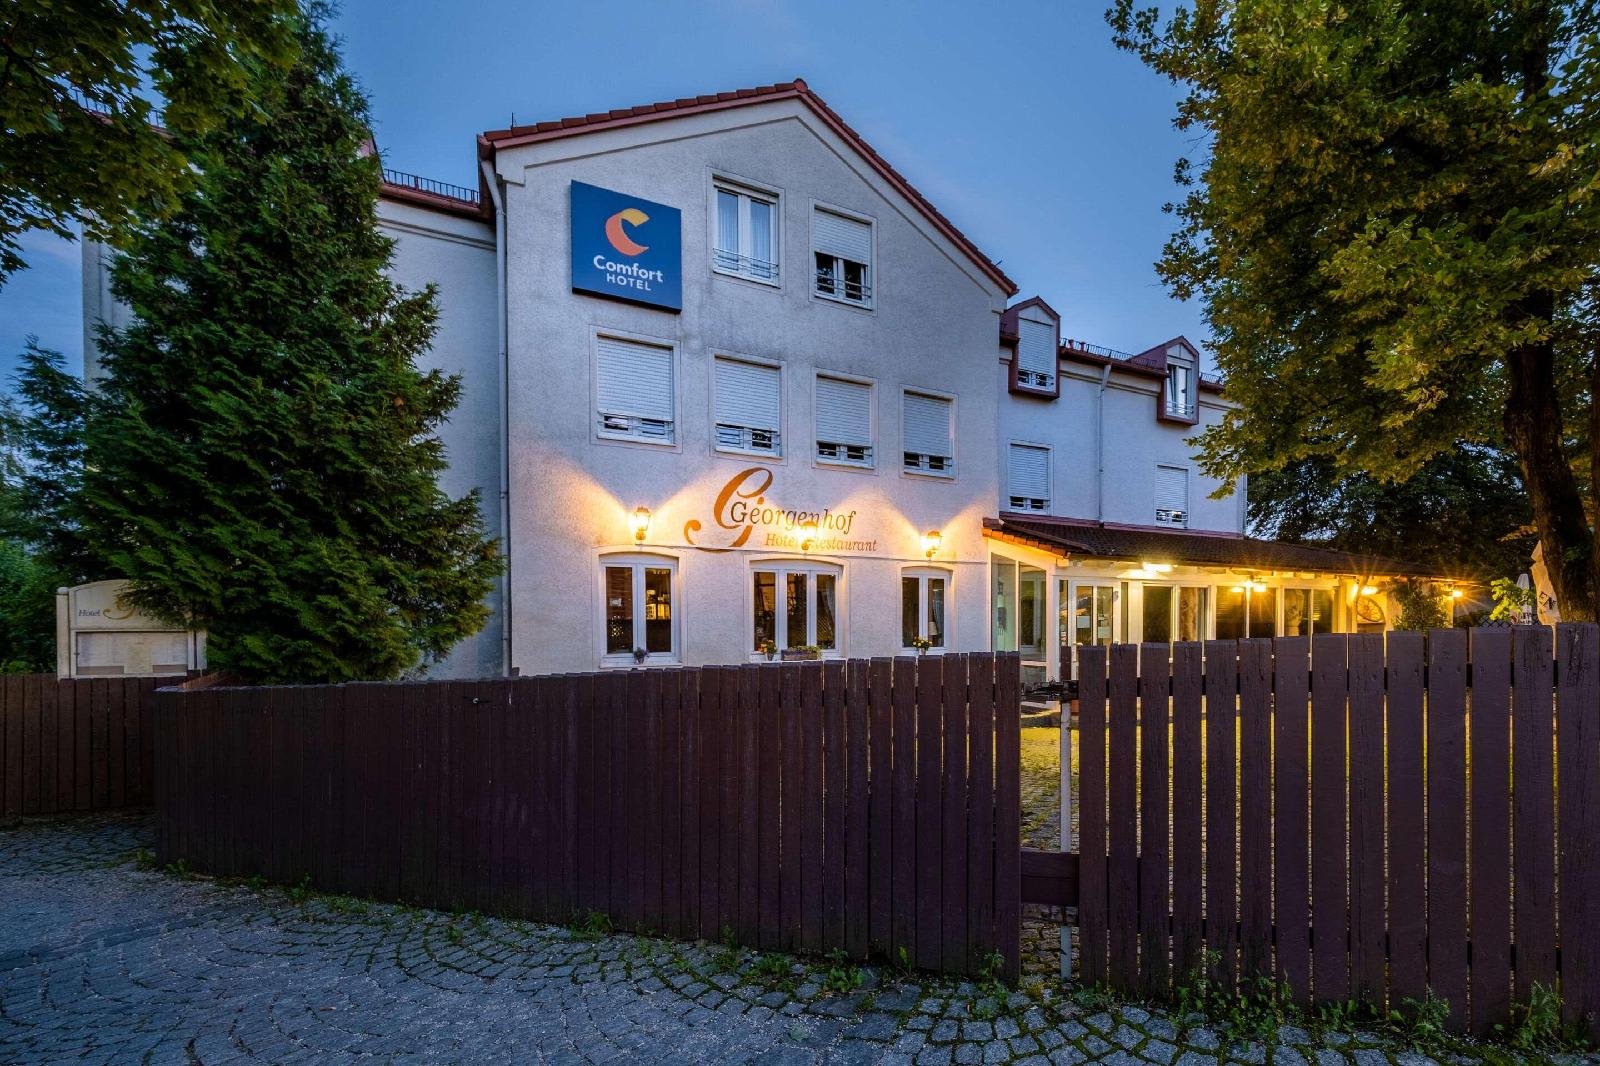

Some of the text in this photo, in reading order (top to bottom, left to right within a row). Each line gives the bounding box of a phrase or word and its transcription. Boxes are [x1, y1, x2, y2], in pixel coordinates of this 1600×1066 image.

[593, 255, 663, 283] Comfort
[606, 272, 652, 291] HOTEL
[730, 501, 857, 534] Georgenhof
[764, 533, 799, 549] Hote
[78, 608, 101, 617] Hotel
